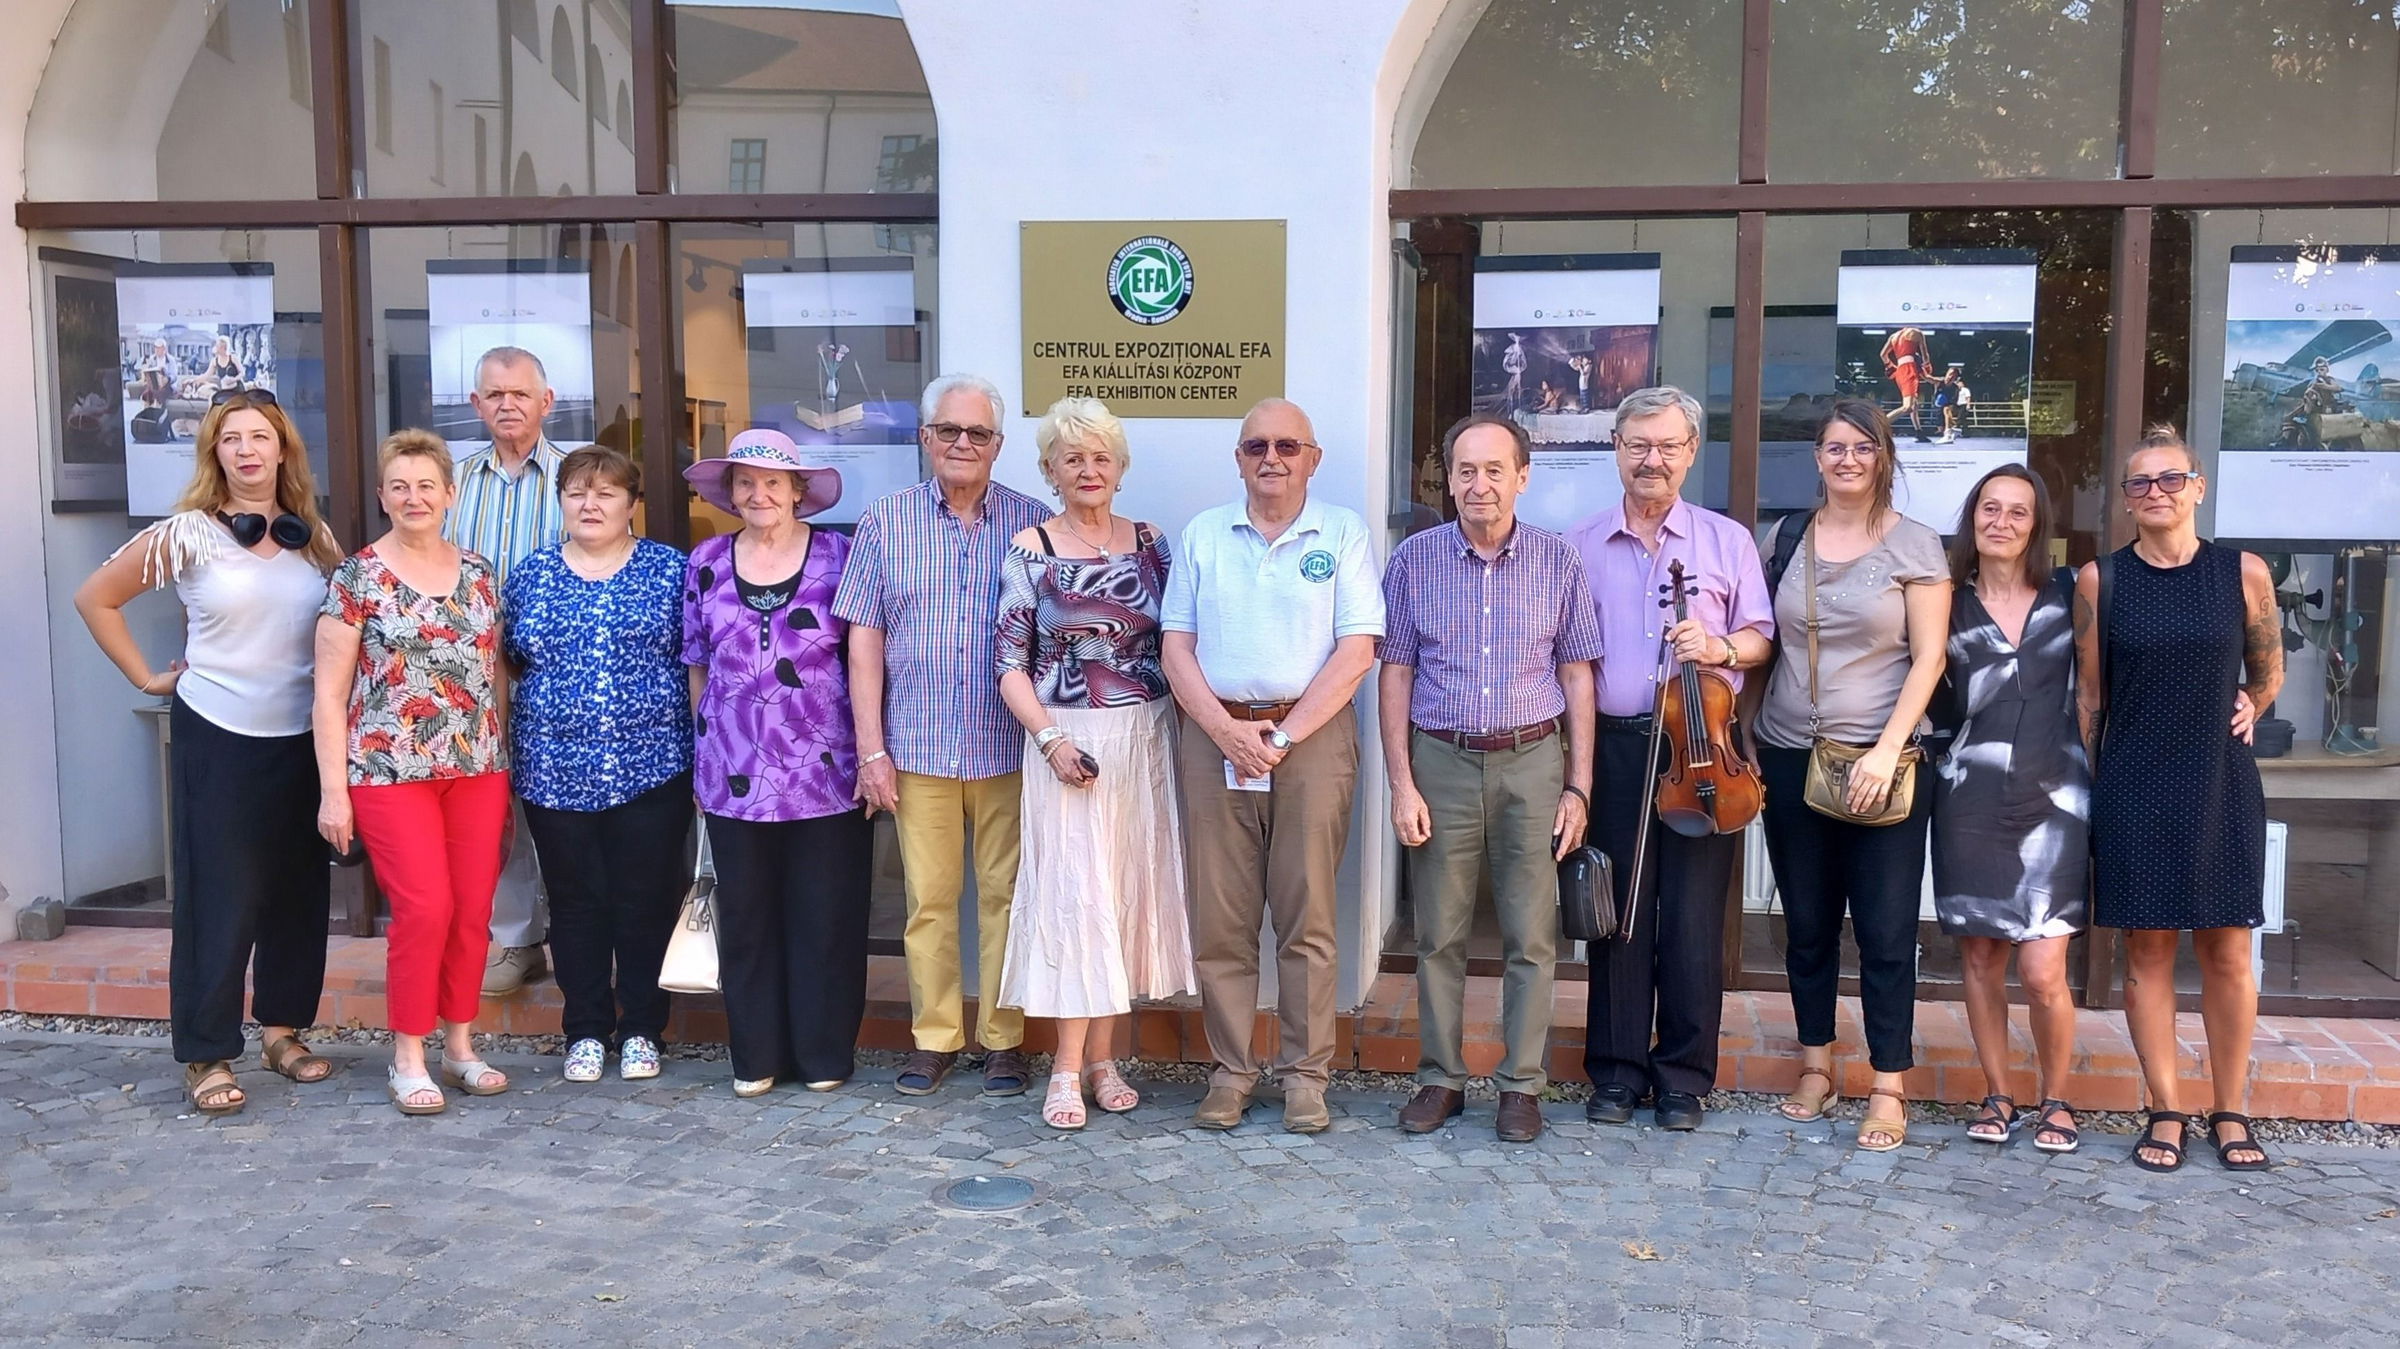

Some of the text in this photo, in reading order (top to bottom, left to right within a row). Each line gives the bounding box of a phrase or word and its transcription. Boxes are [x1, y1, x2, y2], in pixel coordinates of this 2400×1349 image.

[1132, 268, 1169, 293] EFA
[1033, 342, 1111, 358] CENTRUL
[1240, 342, 1272, 358] EFA
[1063, 362, 1242, 379] EFA KIÁLLÍTÁSI KÖZPONT
[1066, 385, 1238, 399] EFA EXHIBITION CENTER
[1310, 561, 1326, 571] EFA
